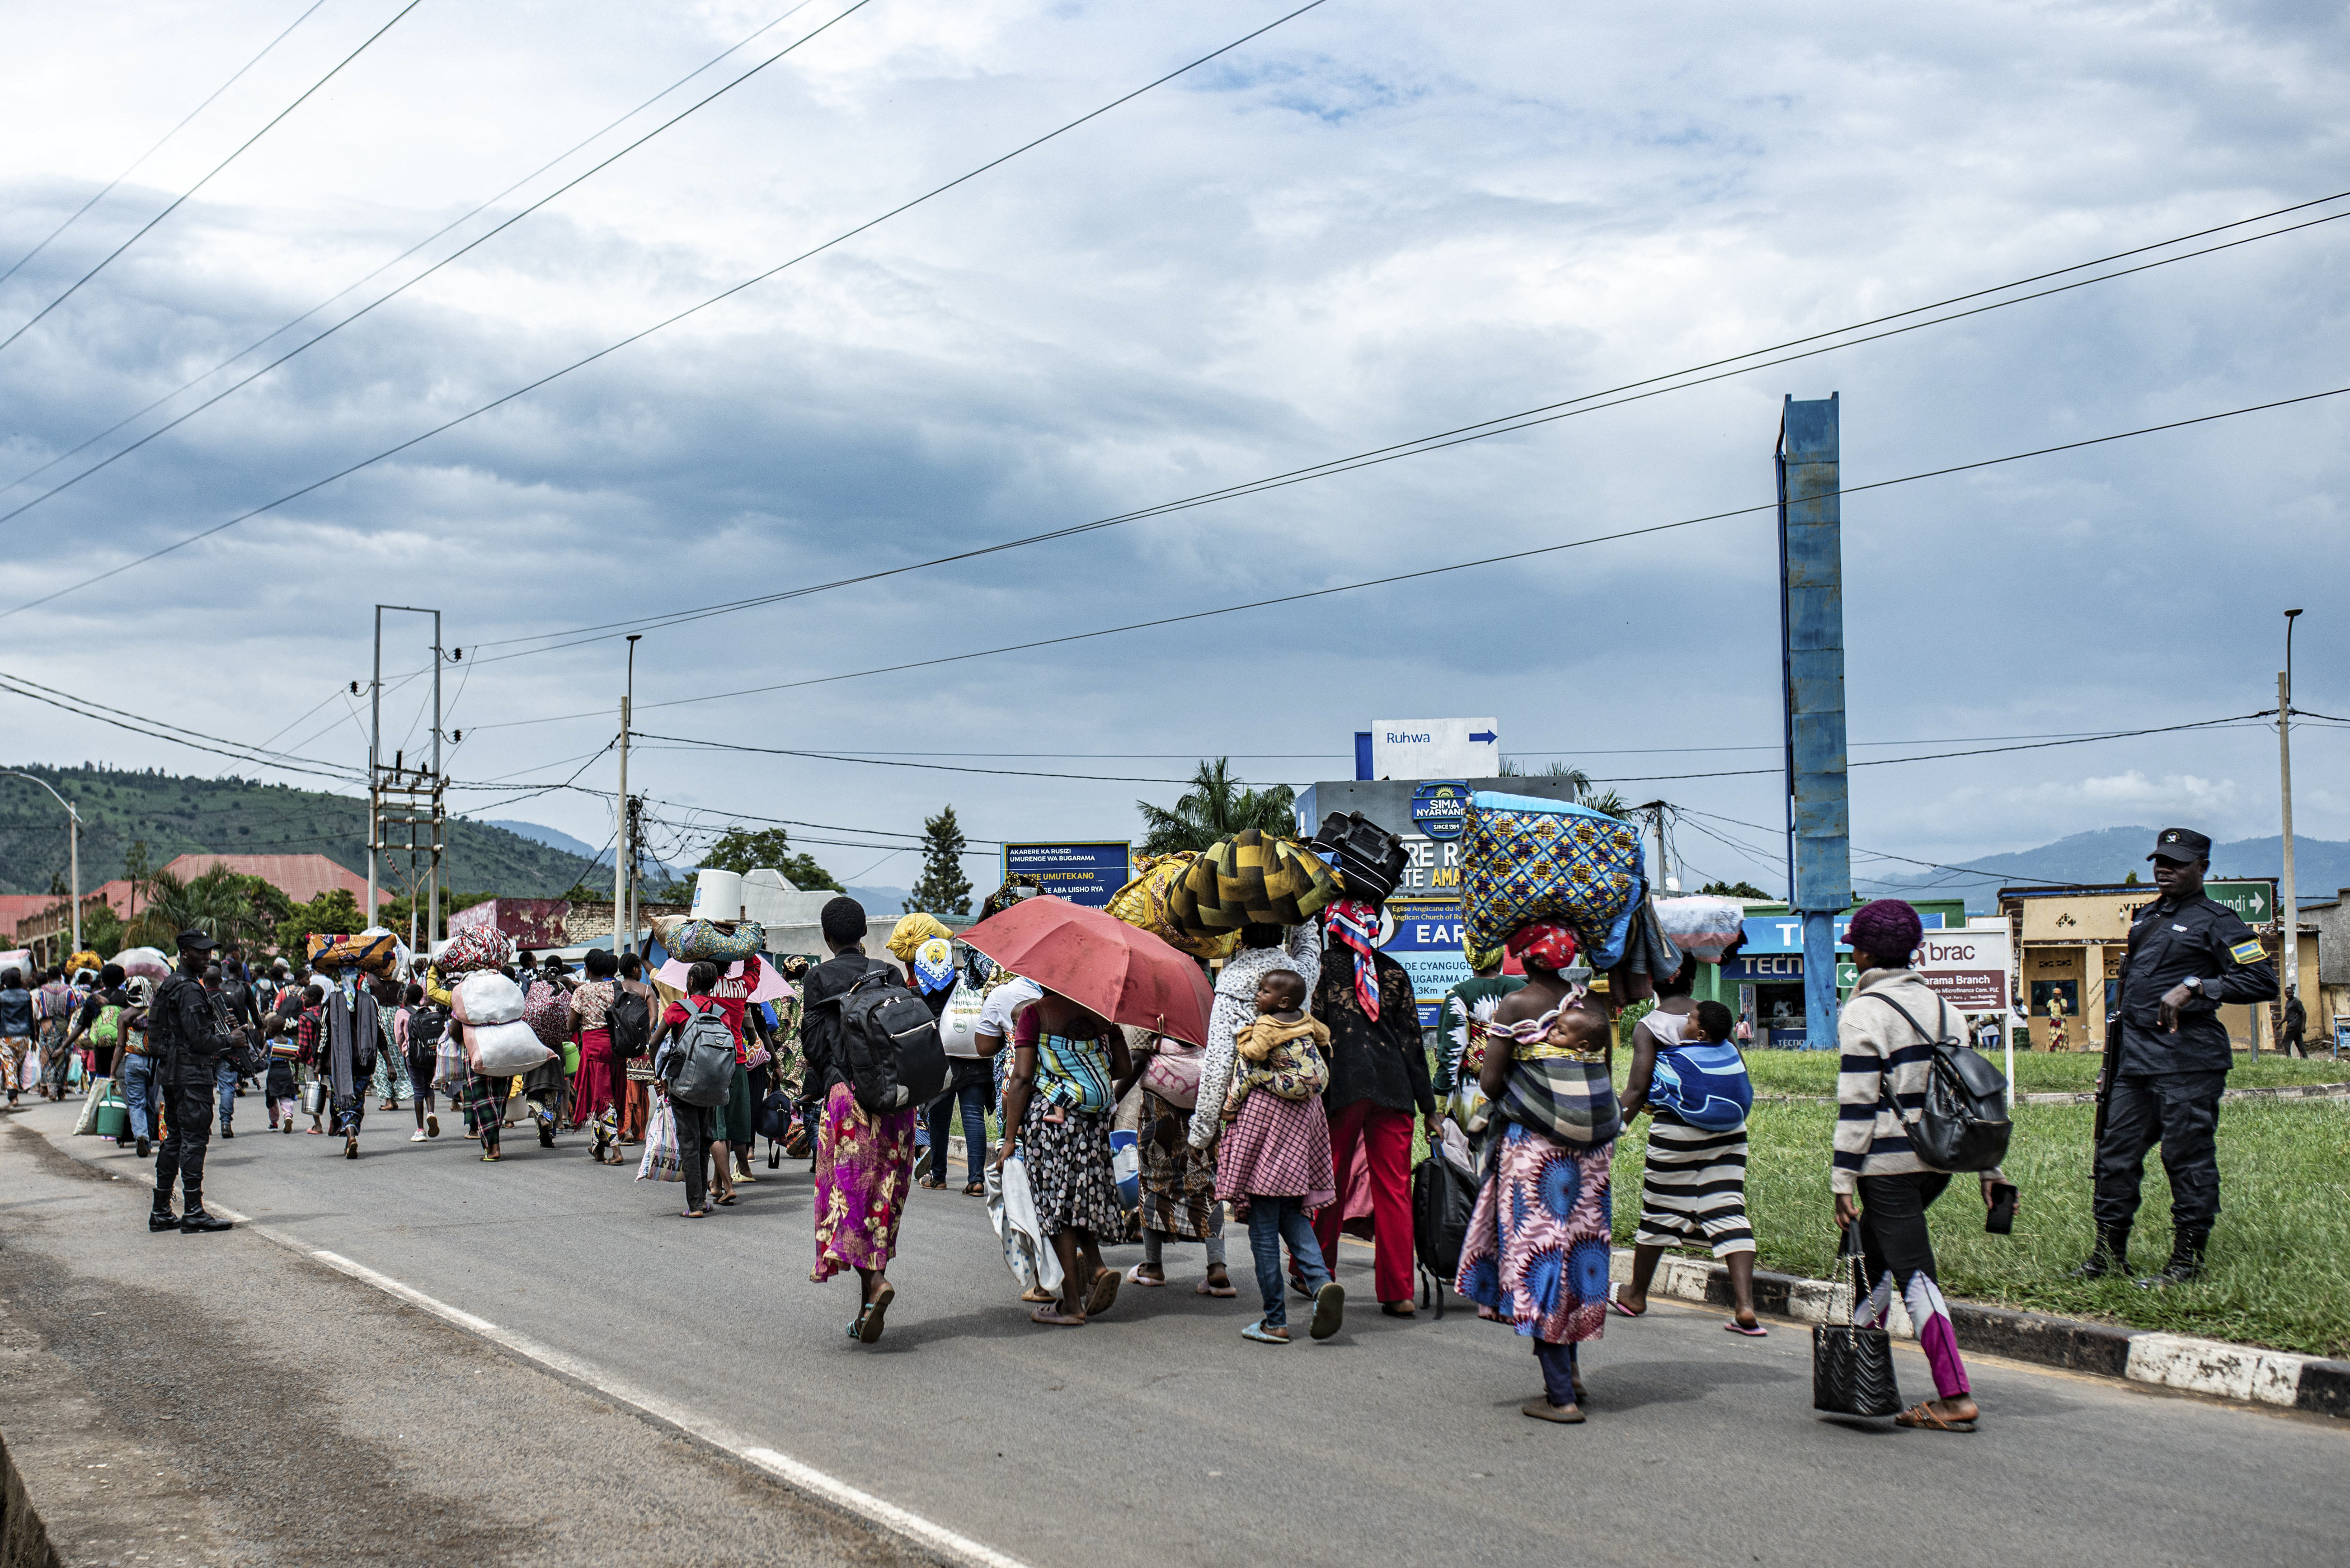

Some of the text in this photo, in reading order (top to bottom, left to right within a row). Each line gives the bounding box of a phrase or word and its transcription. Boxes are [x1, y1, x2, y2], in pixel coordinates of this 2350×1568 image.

[1387, 732, 1430, 743] Ruhwa
[1430, 799, 1460, 809] SIMA
[1399, 842, 1434, 868] RE
[1399, 868, 1424, 887] TE
[1930, 942, 1975, 961] brac
[1405, 962, 1417, 971] DE
[1956, 975, 1990, 985] Branch
[651, 1155, 684, 1172] AFRI
